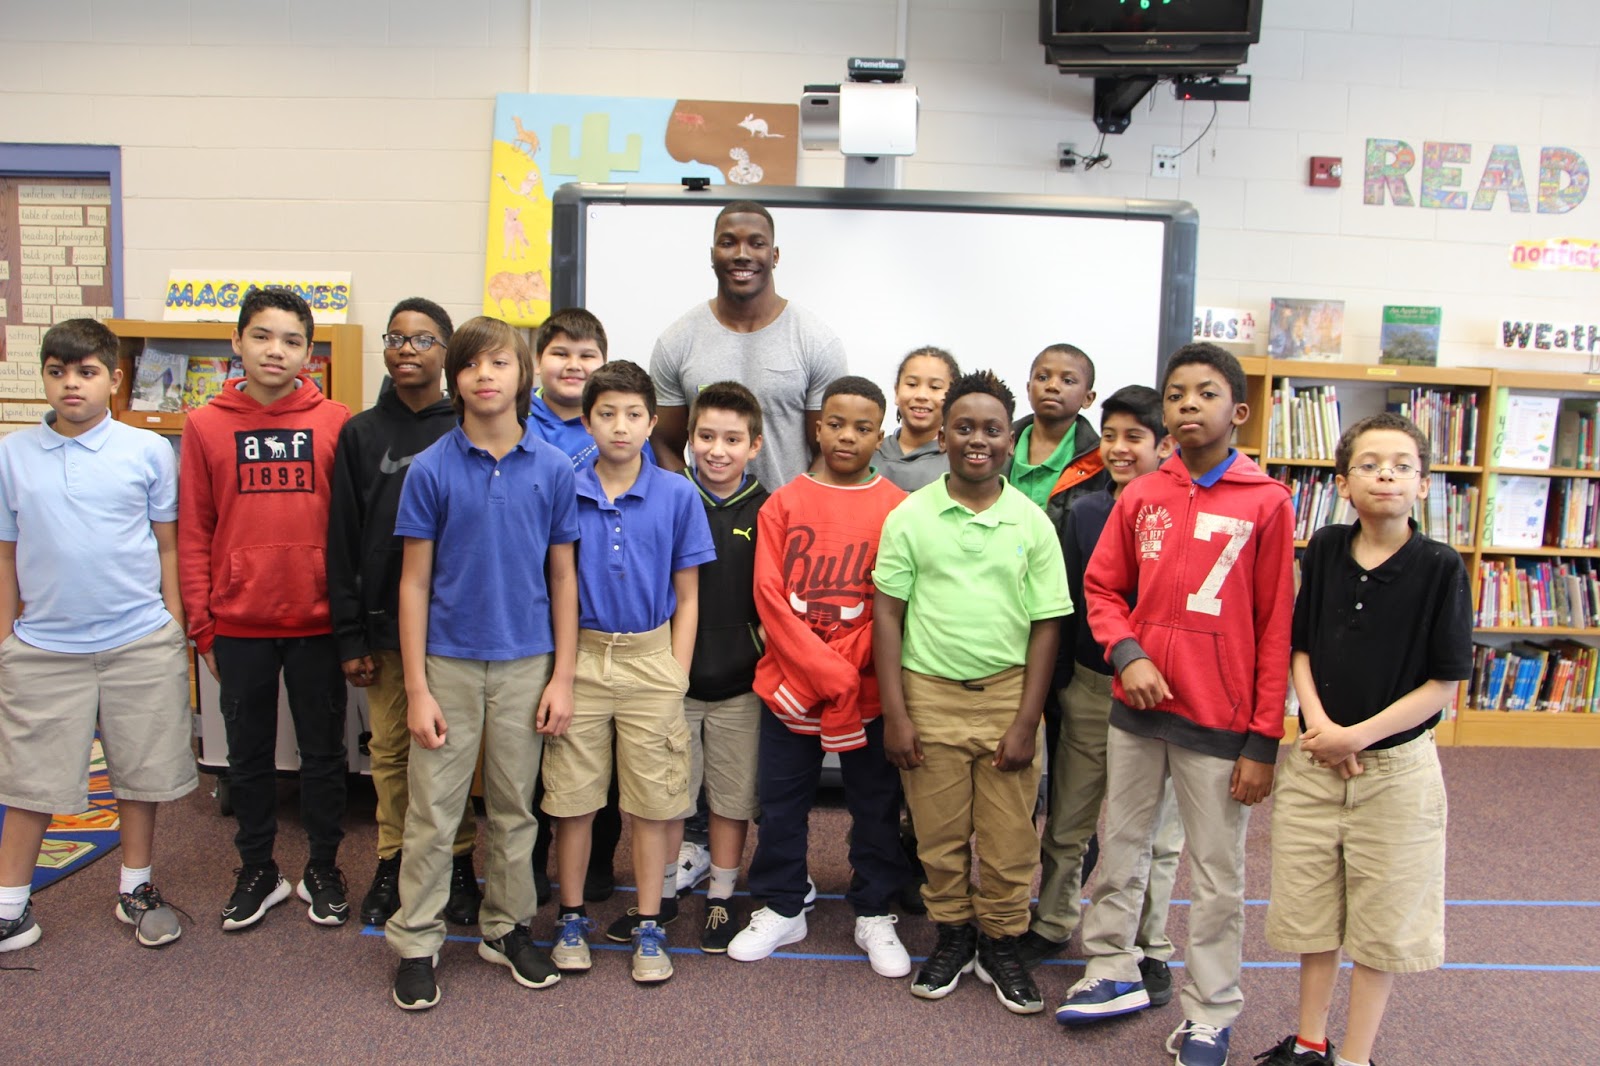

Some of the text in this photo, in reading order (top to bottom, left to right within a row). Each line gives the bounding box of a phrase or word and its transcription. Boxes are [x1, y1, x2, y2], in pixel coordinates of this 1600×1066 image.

[854, 59, 899, 69] Promethean
[1363, 138, 1590, 214] READ
[20, 188, 55, 199] nonfiction
[61, 188, 77, 199] text
[21, 209, 81, 220] table of contents
[22, 230, 55, 244] heading
[58, 231, 103, 245] photographs
[22, 247, 65, 261] bold print
[73, 250, 105, 264] glossary
[1512, 239, 1600, 269] nonfict
[21, 272, 50, 281] caption
[53, 272, 77, 282] graph
[80, 269, 102, 280] chart
[22, 289, 56, 300] diagram
[58, 290, 80, 300] index
[23, 308, 49, 319] details
[1502, 320, 1600, 352] WEath
[7, 349, 33, 358] version
[20, 365, 36, 376] book
[4, 408, 24, 419] spine
[244, 432, 307, 459] a f
[249, 467, 305, 487] 1892
[1156, 505, 1173, 529] SQUAD
[1483, 497, 1496, 541] 500
[1186, 511, 1254, 617] 7
